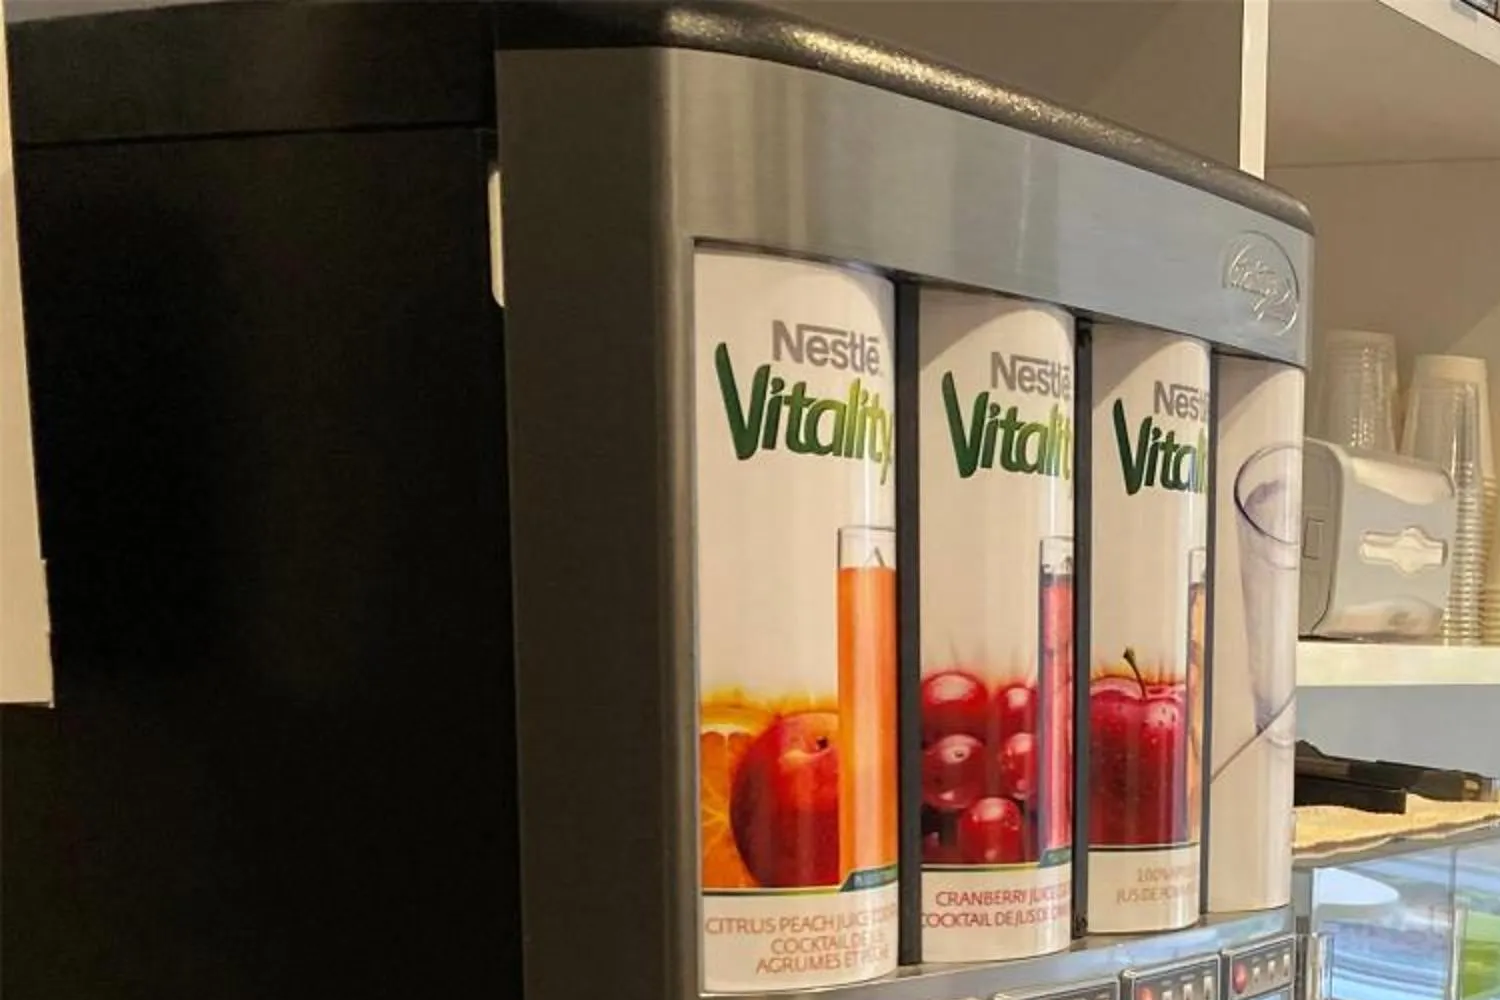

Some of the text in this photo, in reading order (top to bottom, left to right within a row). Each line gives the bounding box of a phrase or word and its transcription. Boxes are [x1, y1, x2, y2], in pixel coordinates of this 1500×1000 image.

[772, 319, 881, 376] Nestlé
[715, 341, 893, 486] Vitality
[941, 370, 1071, 481] Vitalit
[935, 889, 1027, 907] CRANBERRY
[705, 916, 776, 935] CITRUS
[779, 914, 834, 933] PEACH
[755, 953, 842, 975] AGRUMES
